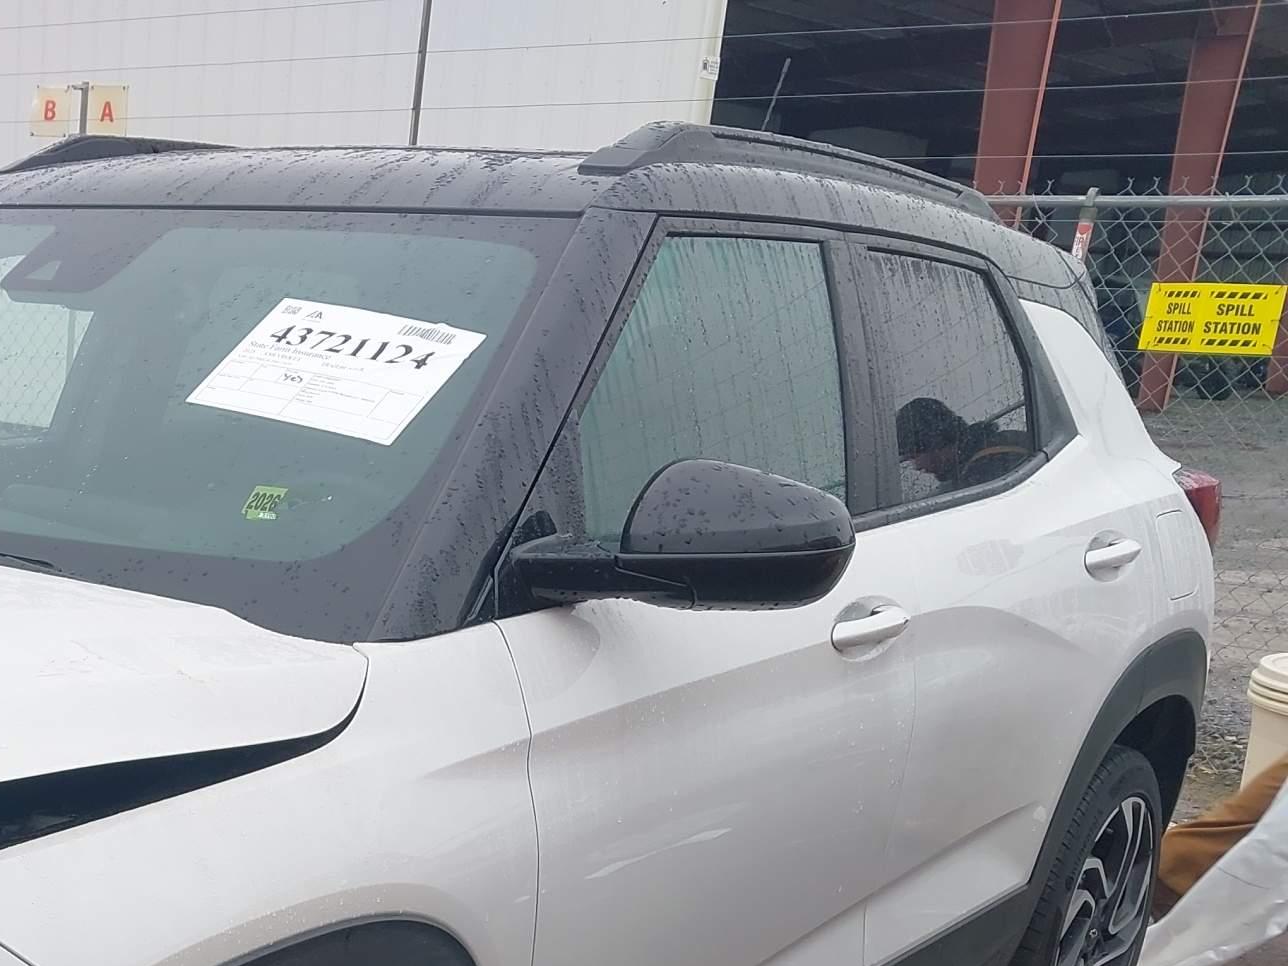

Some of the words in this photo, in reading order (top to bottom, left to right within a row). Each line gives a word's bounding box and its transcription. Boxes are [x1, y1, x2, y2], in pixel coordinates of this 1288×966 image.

[44, 99, 57, 121] B
[99, 101, 114, 123] A
[1166, 302, 1192, 315] SPILL
[1216, 303, 1255, 317] SPILL
[1156, 320, 1195, 333] STATION
[1203, 321, 1262, 335] STATION
[269, 324, 436, 370] 43721124
[246, 491, 282, 512] 2026
